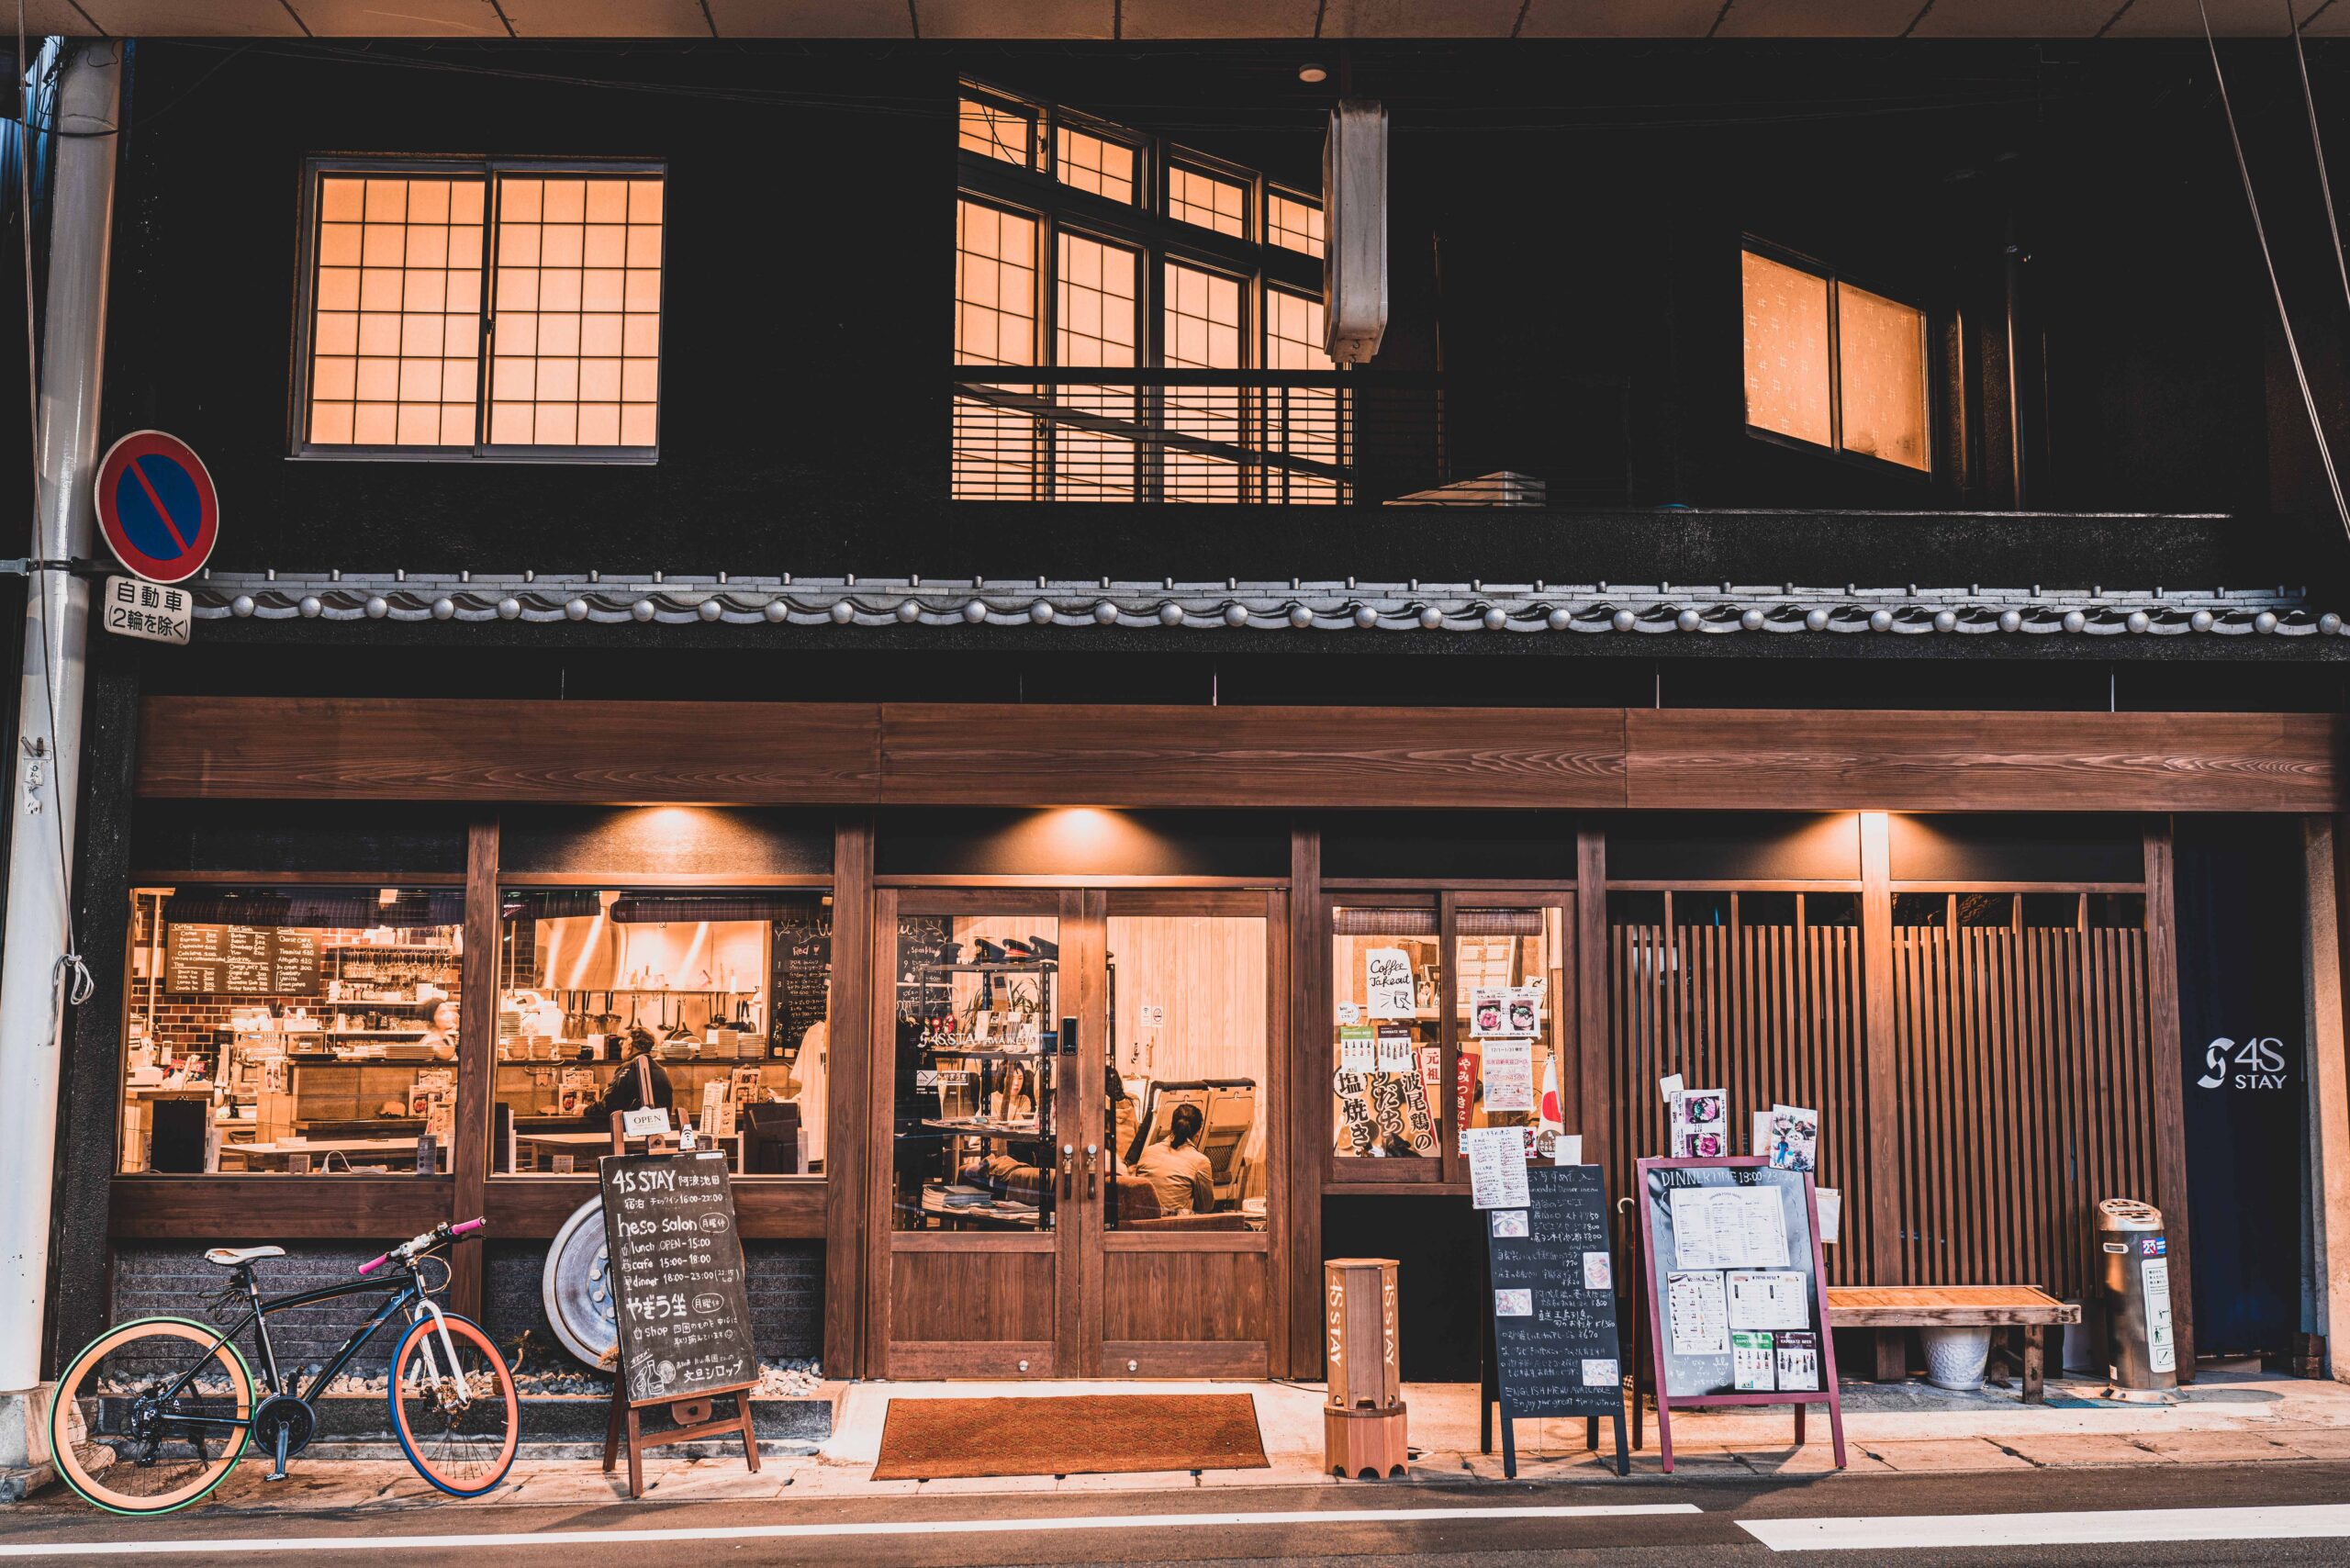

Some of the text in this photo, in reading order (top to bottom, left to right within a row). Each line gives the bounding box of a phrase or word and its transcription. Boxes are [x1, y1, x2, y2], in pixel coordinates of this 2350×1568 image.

[118, 581, 183, 612] 自動車
[109, 605, 188, 641] (2輪を除く)
[792, 945, 810, 955] Red
[1371, 960, 1407, 975] Coffee
[1370, 973, 1410, 988] Takeout
[2234, 1037, 2286, 1072] 4S
[1427, 1051, 1439, 1081] 元祖
[2235, 1074, 2287, 1090] STAY
[633, 1114, 661, 1124] OPEN
[612, 1170, 720, 1193] 4S STAY 阿波池田
[1662, 1171, 1709, 1186] DINNER
[1711, 1171, 1737, 1182] TIME
[624, 1197, 644, 1210] 宿泊
[617, 1214, 657, 1237] heso
[662, 1215, 698, 1232] salon
[632, 1241, 655, 1254] lunch
[632, 1258, 654, 1271] cafe
[633, 1274, 658, 1287] dinner
[626, 1293, 720, 1321] やぎう坐 月曜休
[1329, 1275, 1344, 1367] 4S STAY
[1384, 1275, 1395, 1367] 4S STAY
[644, 1326, 668, 1338] shop
[684, 1360, 744, 1383] 文旦シロップ
[1505, 1385, 1544, 1397] ENGLISH
[1513, 1398, 1535, 1412] Enjoy
[1552, 1397, 1573, 1408] great
